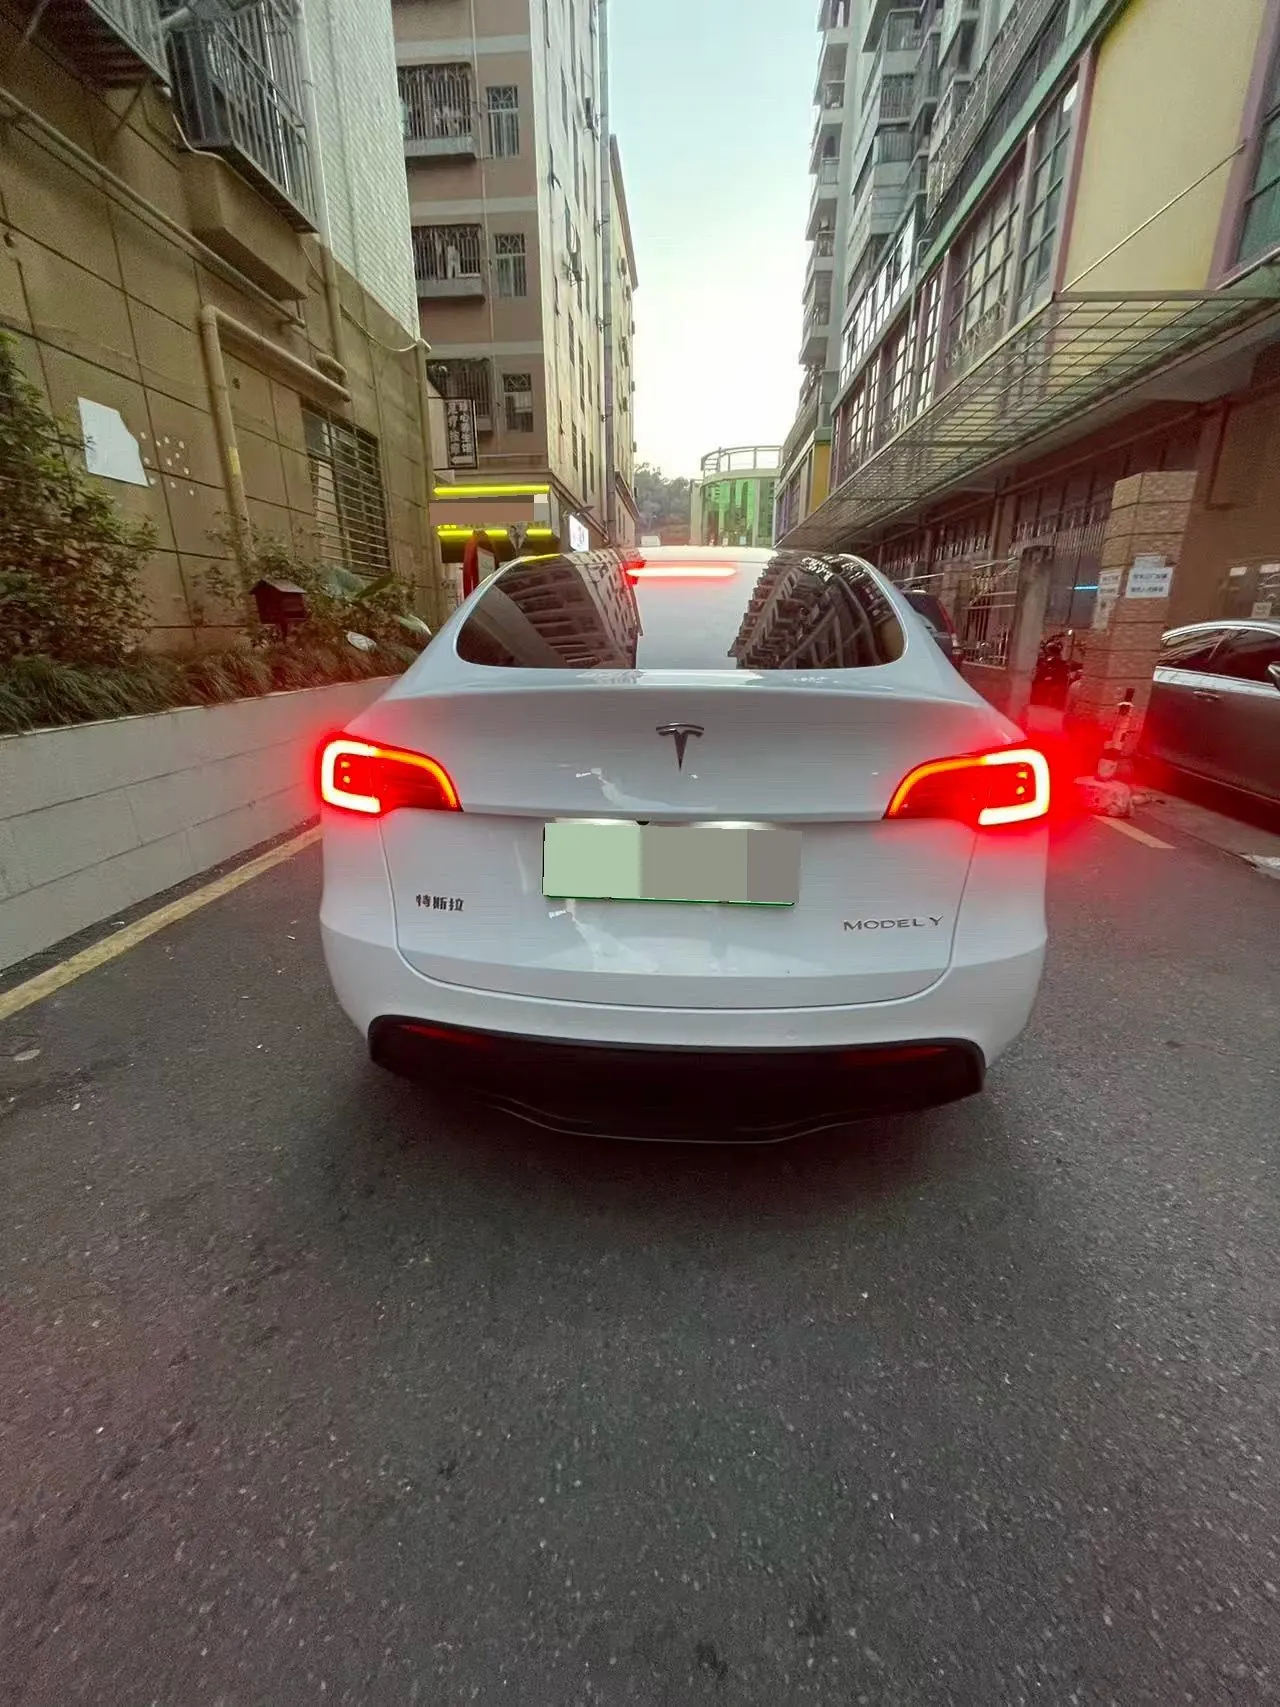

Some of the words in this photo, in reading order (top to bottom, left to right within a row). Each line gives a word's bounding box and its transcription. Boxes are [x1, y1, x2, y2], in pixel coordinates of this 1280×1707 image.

[416, 894, 464, 912] 特斯拉
[843, 918, 925, 931] MODEL
[928, 915, 944, 926] Y
